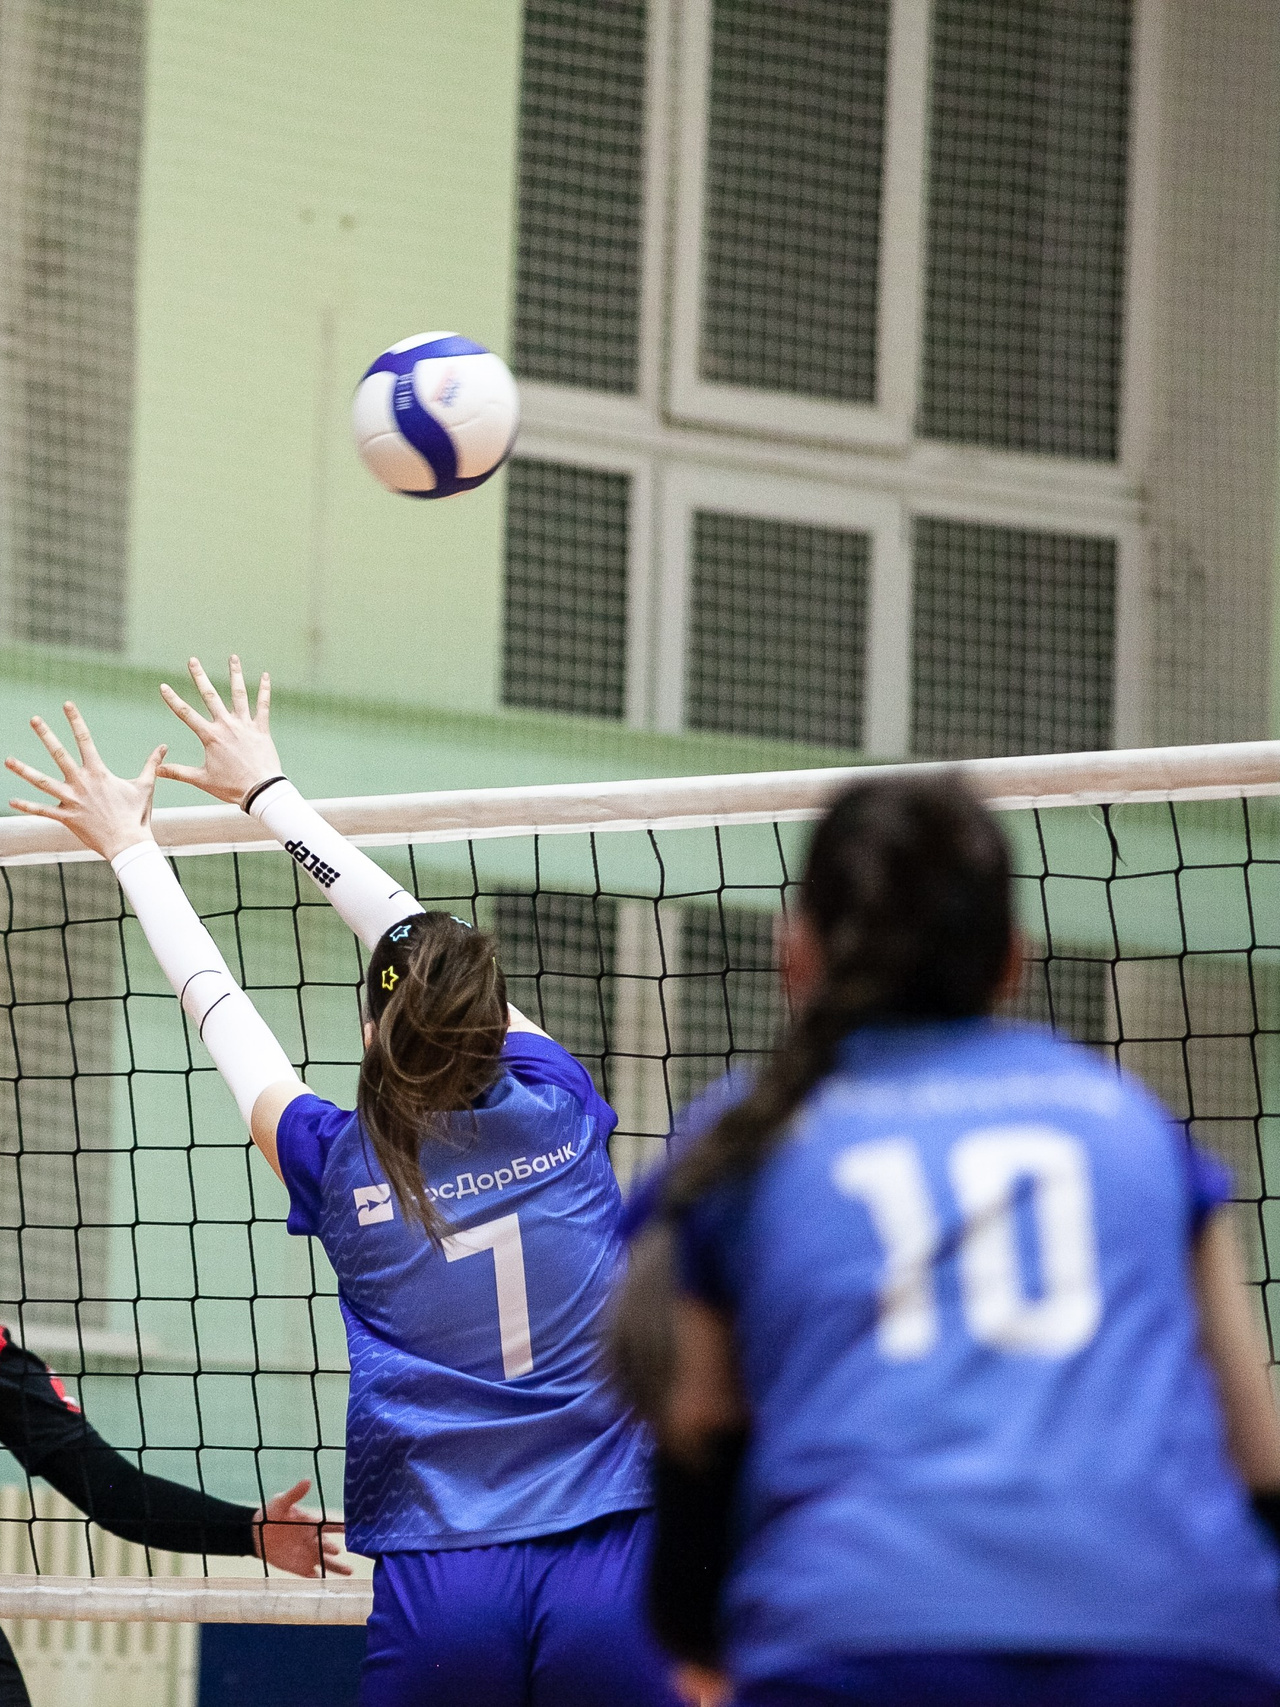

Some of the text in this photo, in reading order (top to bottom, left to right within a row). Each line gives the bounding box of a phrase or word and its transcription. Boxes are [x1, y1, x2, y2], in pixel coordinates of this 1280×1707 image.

[408, 1142, 577, 1203] осДорБанк
[833, 1127, 1103, 1356] 10
[441, 1213, 534, 1380] 7
